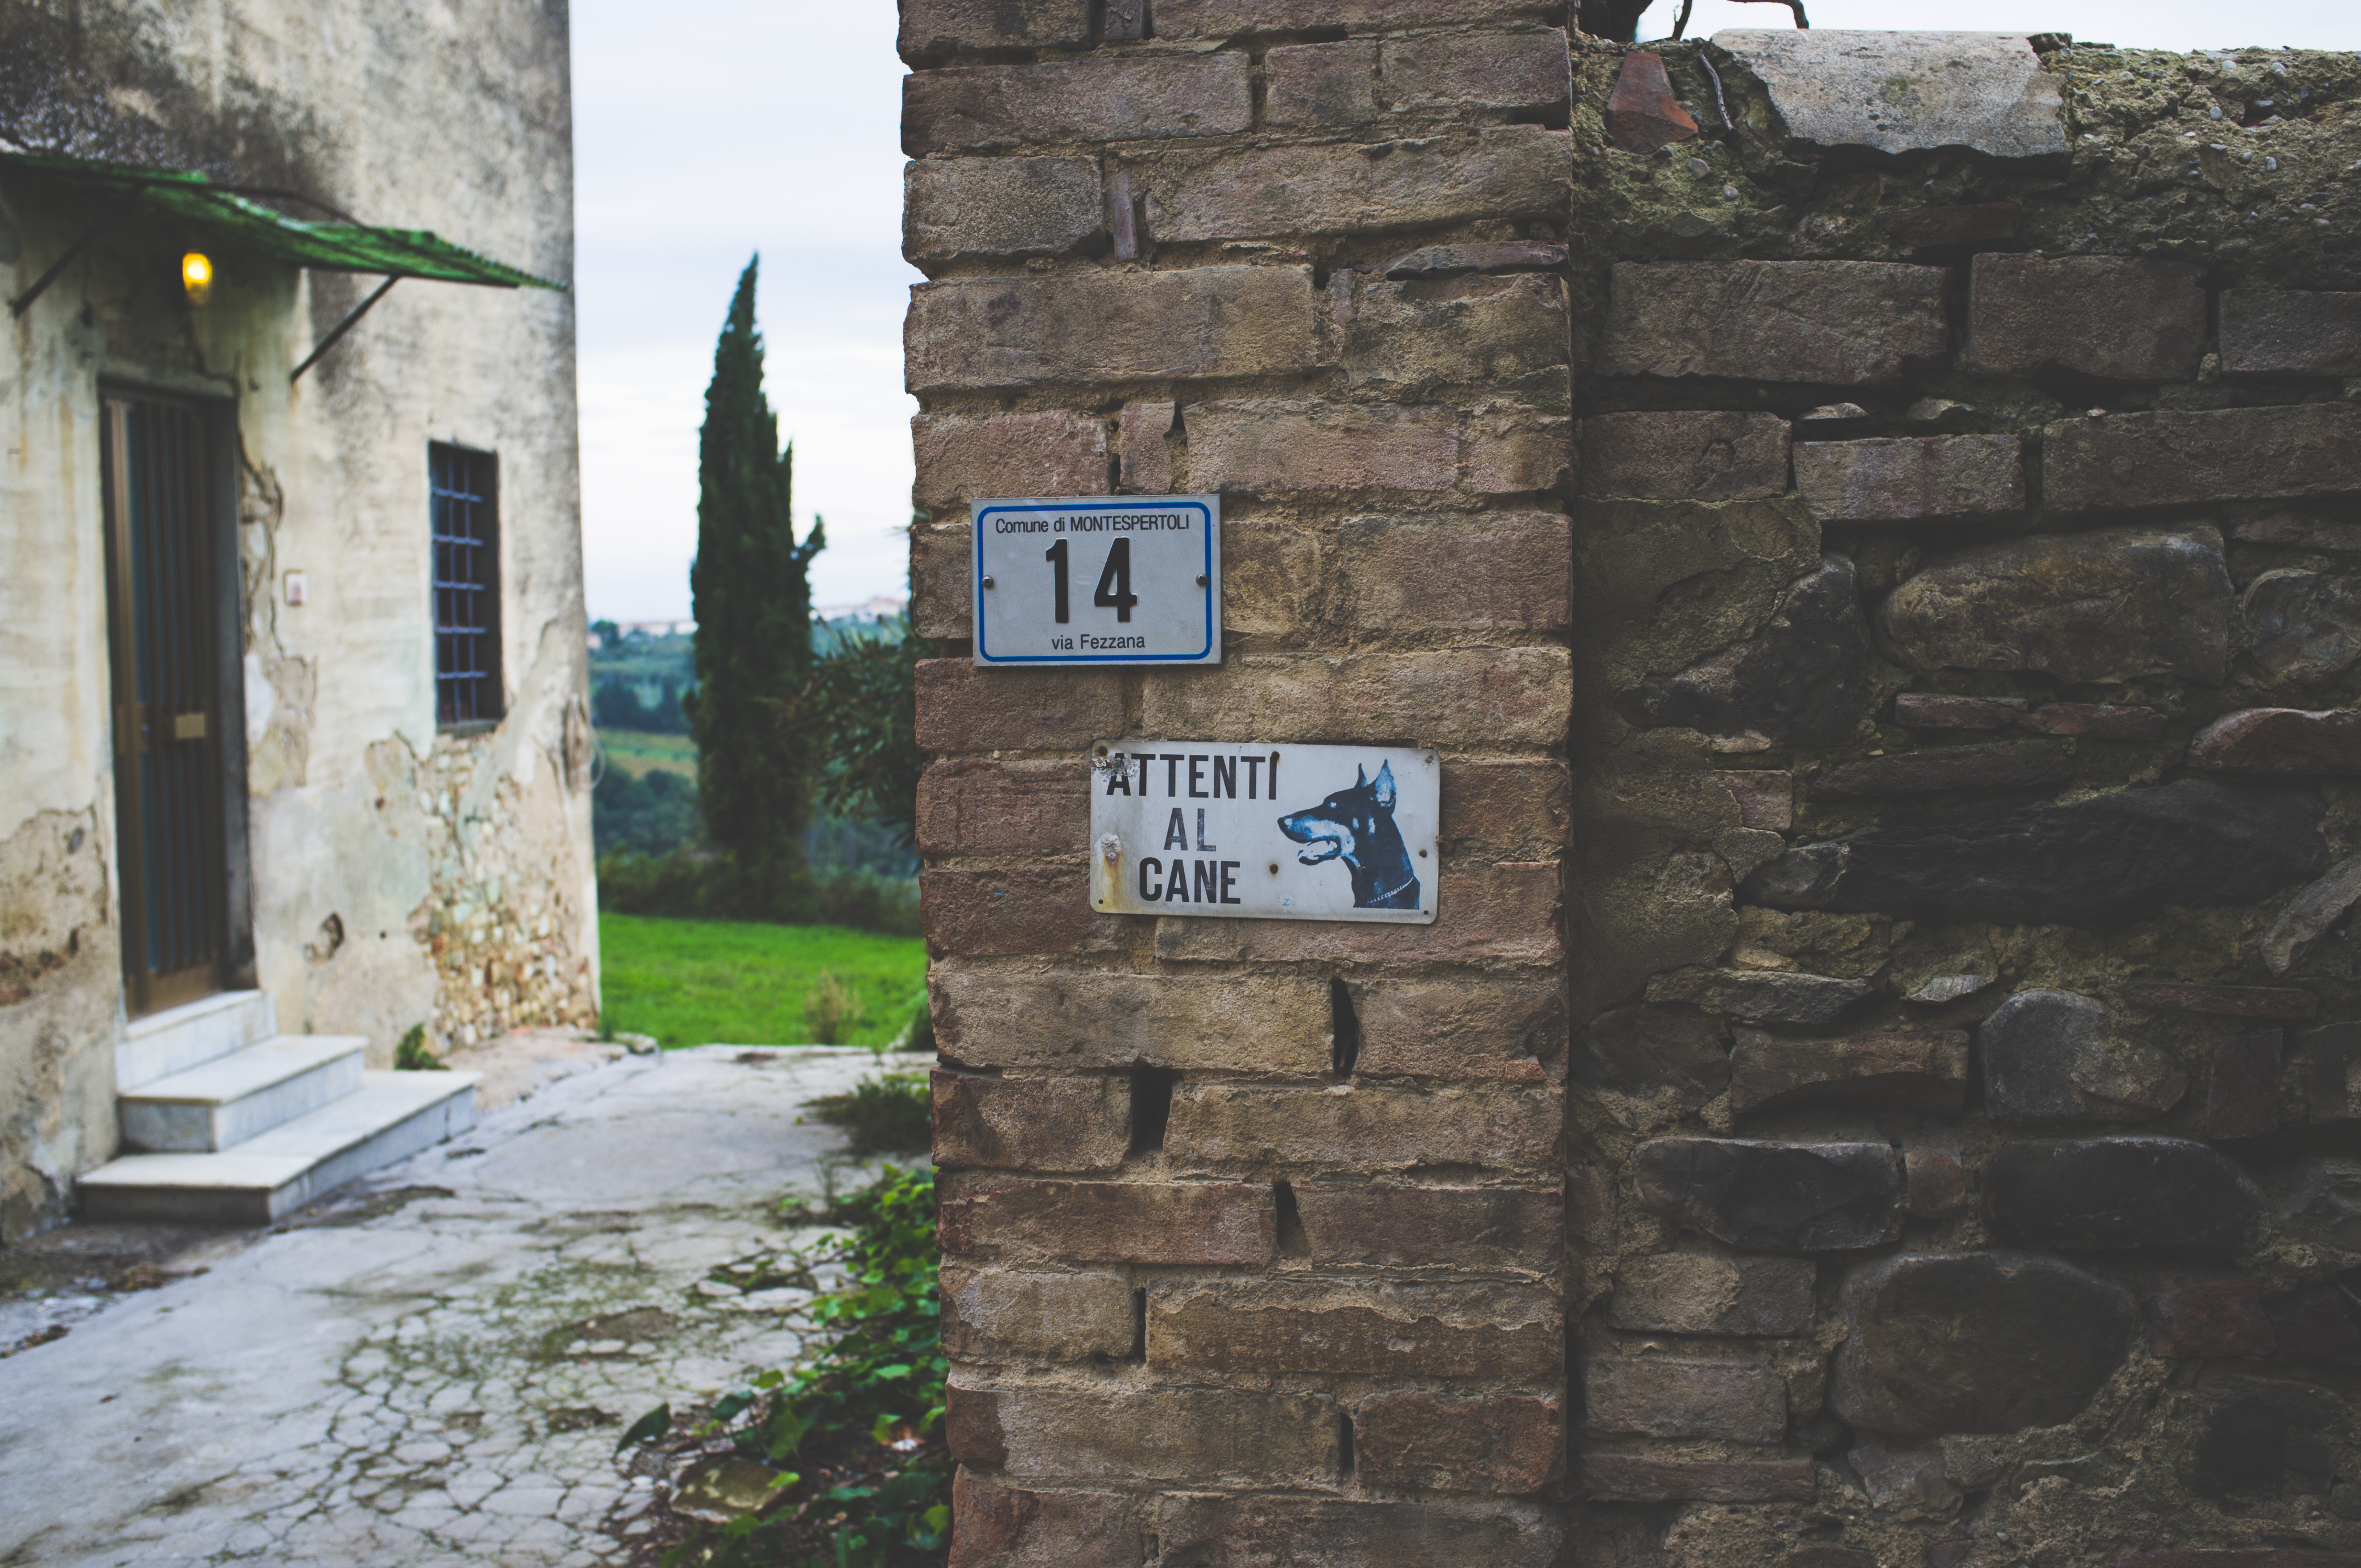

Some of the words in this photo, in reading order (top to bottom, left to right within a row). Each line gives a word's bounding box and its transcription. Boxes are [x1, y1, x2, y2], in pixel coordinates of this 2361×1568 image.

[995, 518, 1049, 534] Comune
[1053, 516, 1065, 532] di
[1070, 514, 1190, 532] MONTESPERTOLI
[1046, 537, 1138, 624] 14
[1051, 634, 1074, 650] via
[1080, 634, 1146, 650] Fezzana
[1106, 752, 1277, 800] ATTENTI
[1163, 807, 1216, 852] AL
[1139, 857, 1241, 905] CANE
